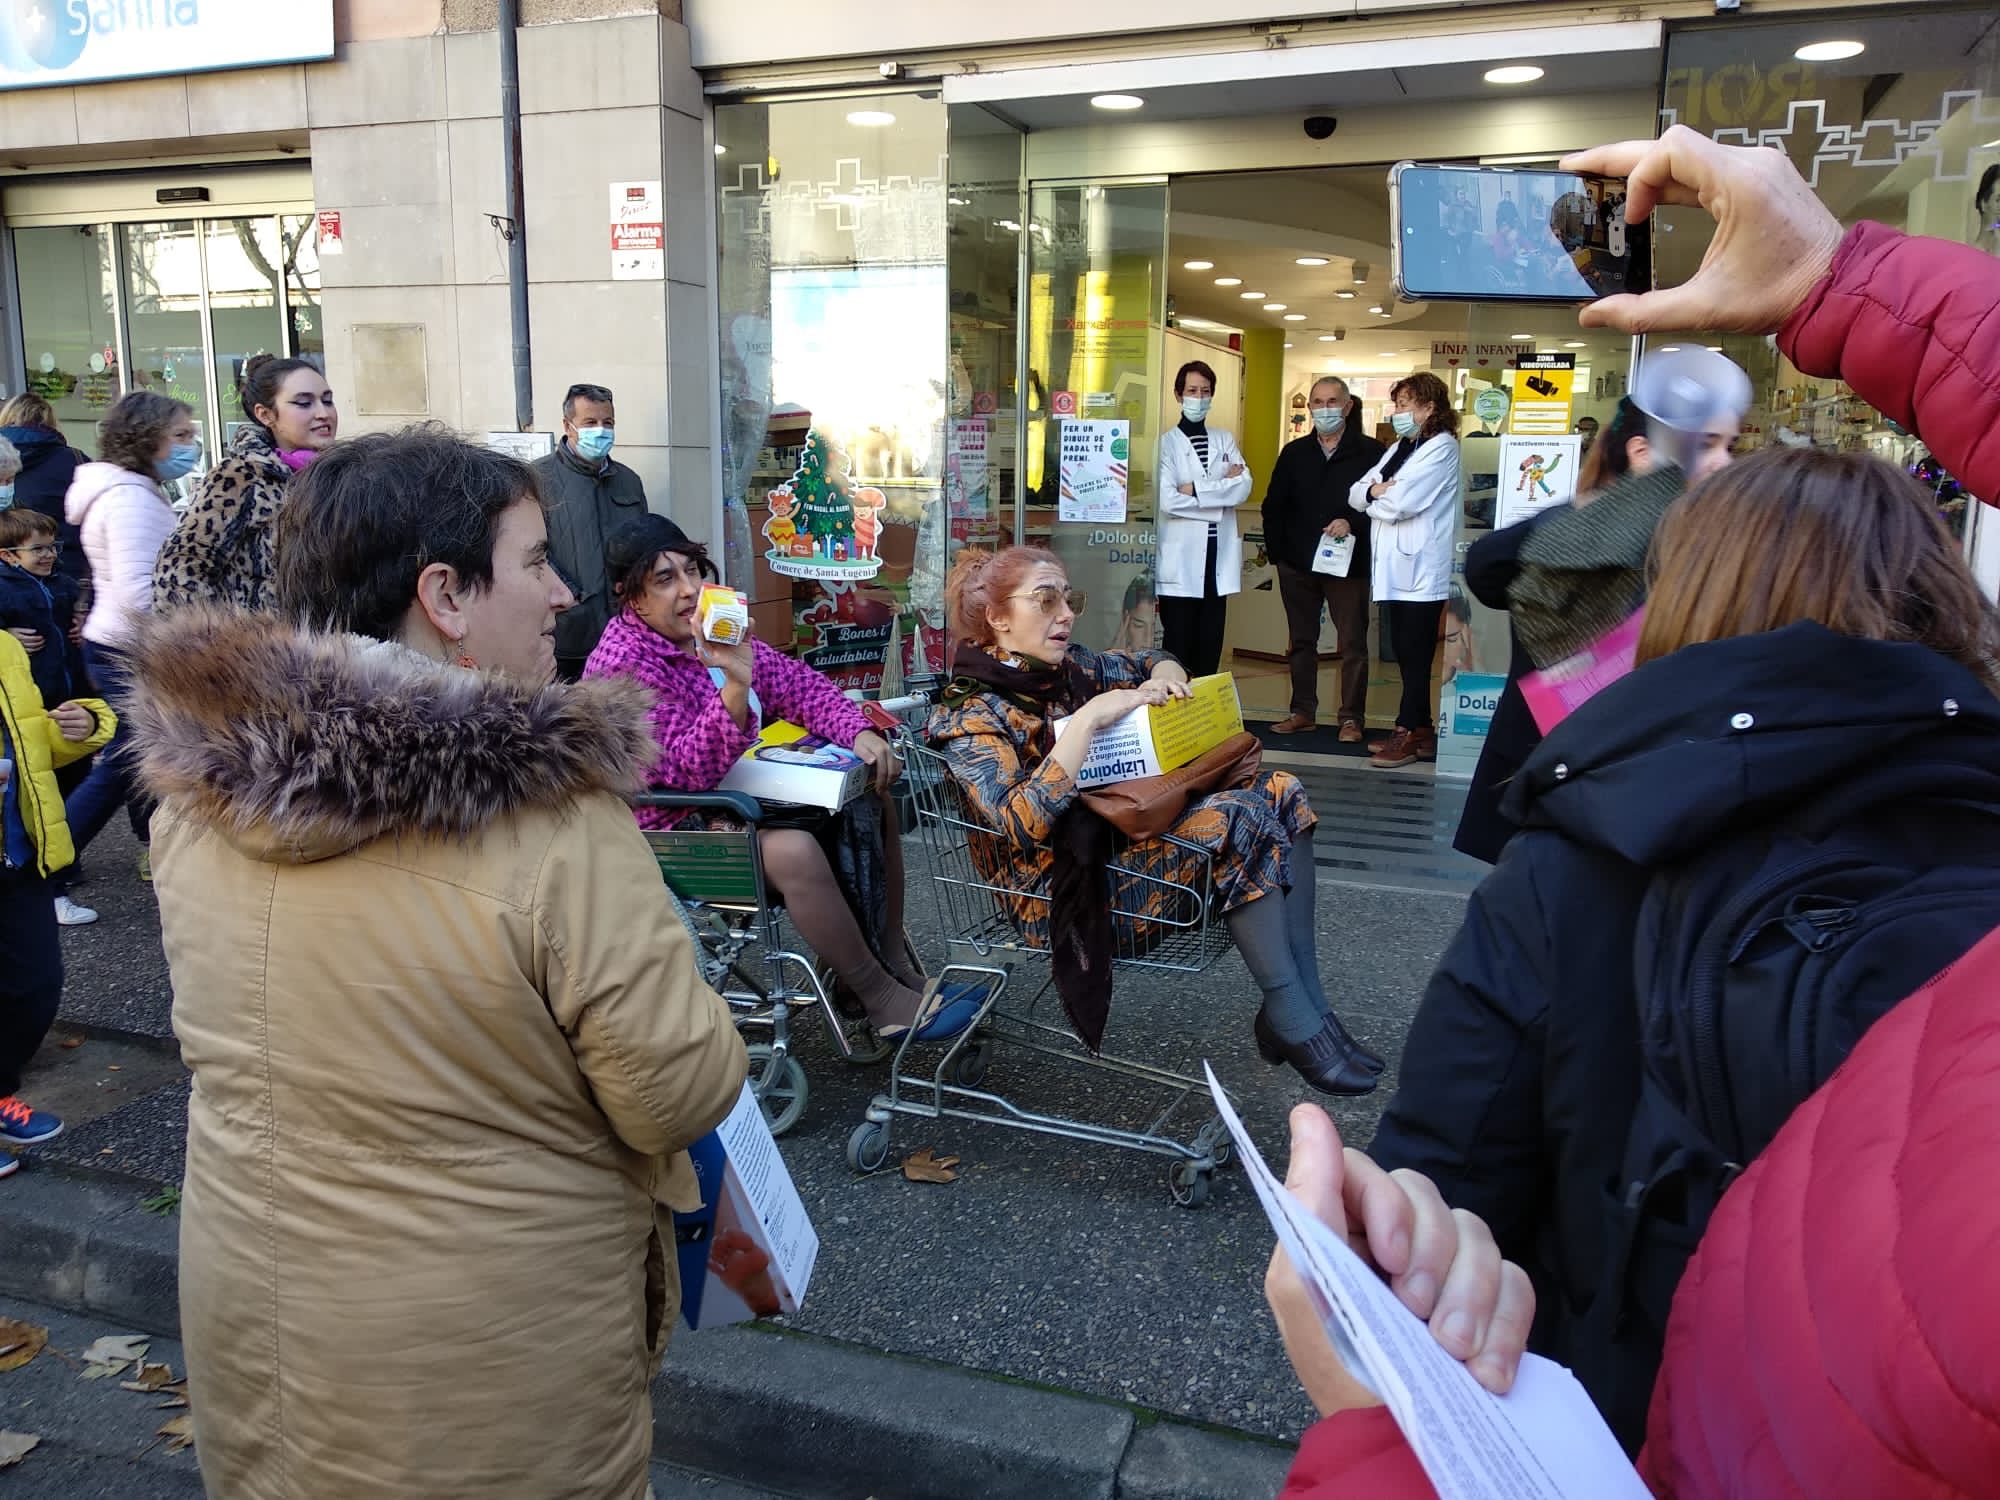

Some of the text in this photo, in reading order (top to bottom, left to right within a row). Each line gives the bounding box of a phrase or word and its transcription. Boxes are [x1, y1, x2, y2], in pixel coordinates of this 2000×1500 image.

[613, 223, 661, 239] Alarma
[1434, 341, 1468, 355] LÍNIA
[1063, 425, 1094, 433] FER UN
[1094, 443, 1104, 452] TÉ
[1063, 454, 1091, 462] PREMI.
[803, 502, 850, 513] FEM NADAL AL BARRI
[1087, 529, 1157, 546] ¿Dolor de
[771, 560, 802, 575] Comerç
[804, 566, 814, 576] de
[815, 567, 839, 577] Santa
[838, 624, 887, 641] Bones i
[813, 647, 881, 667] saludables
[848, 674, 861, 687] la
[862, 671, 883, 689] far
[1459, 694, 1500, 711] Dola
[1095, 747, 1142, 760] Clorhexidina
[1080, 759, 1146, 782] Lizipaina
